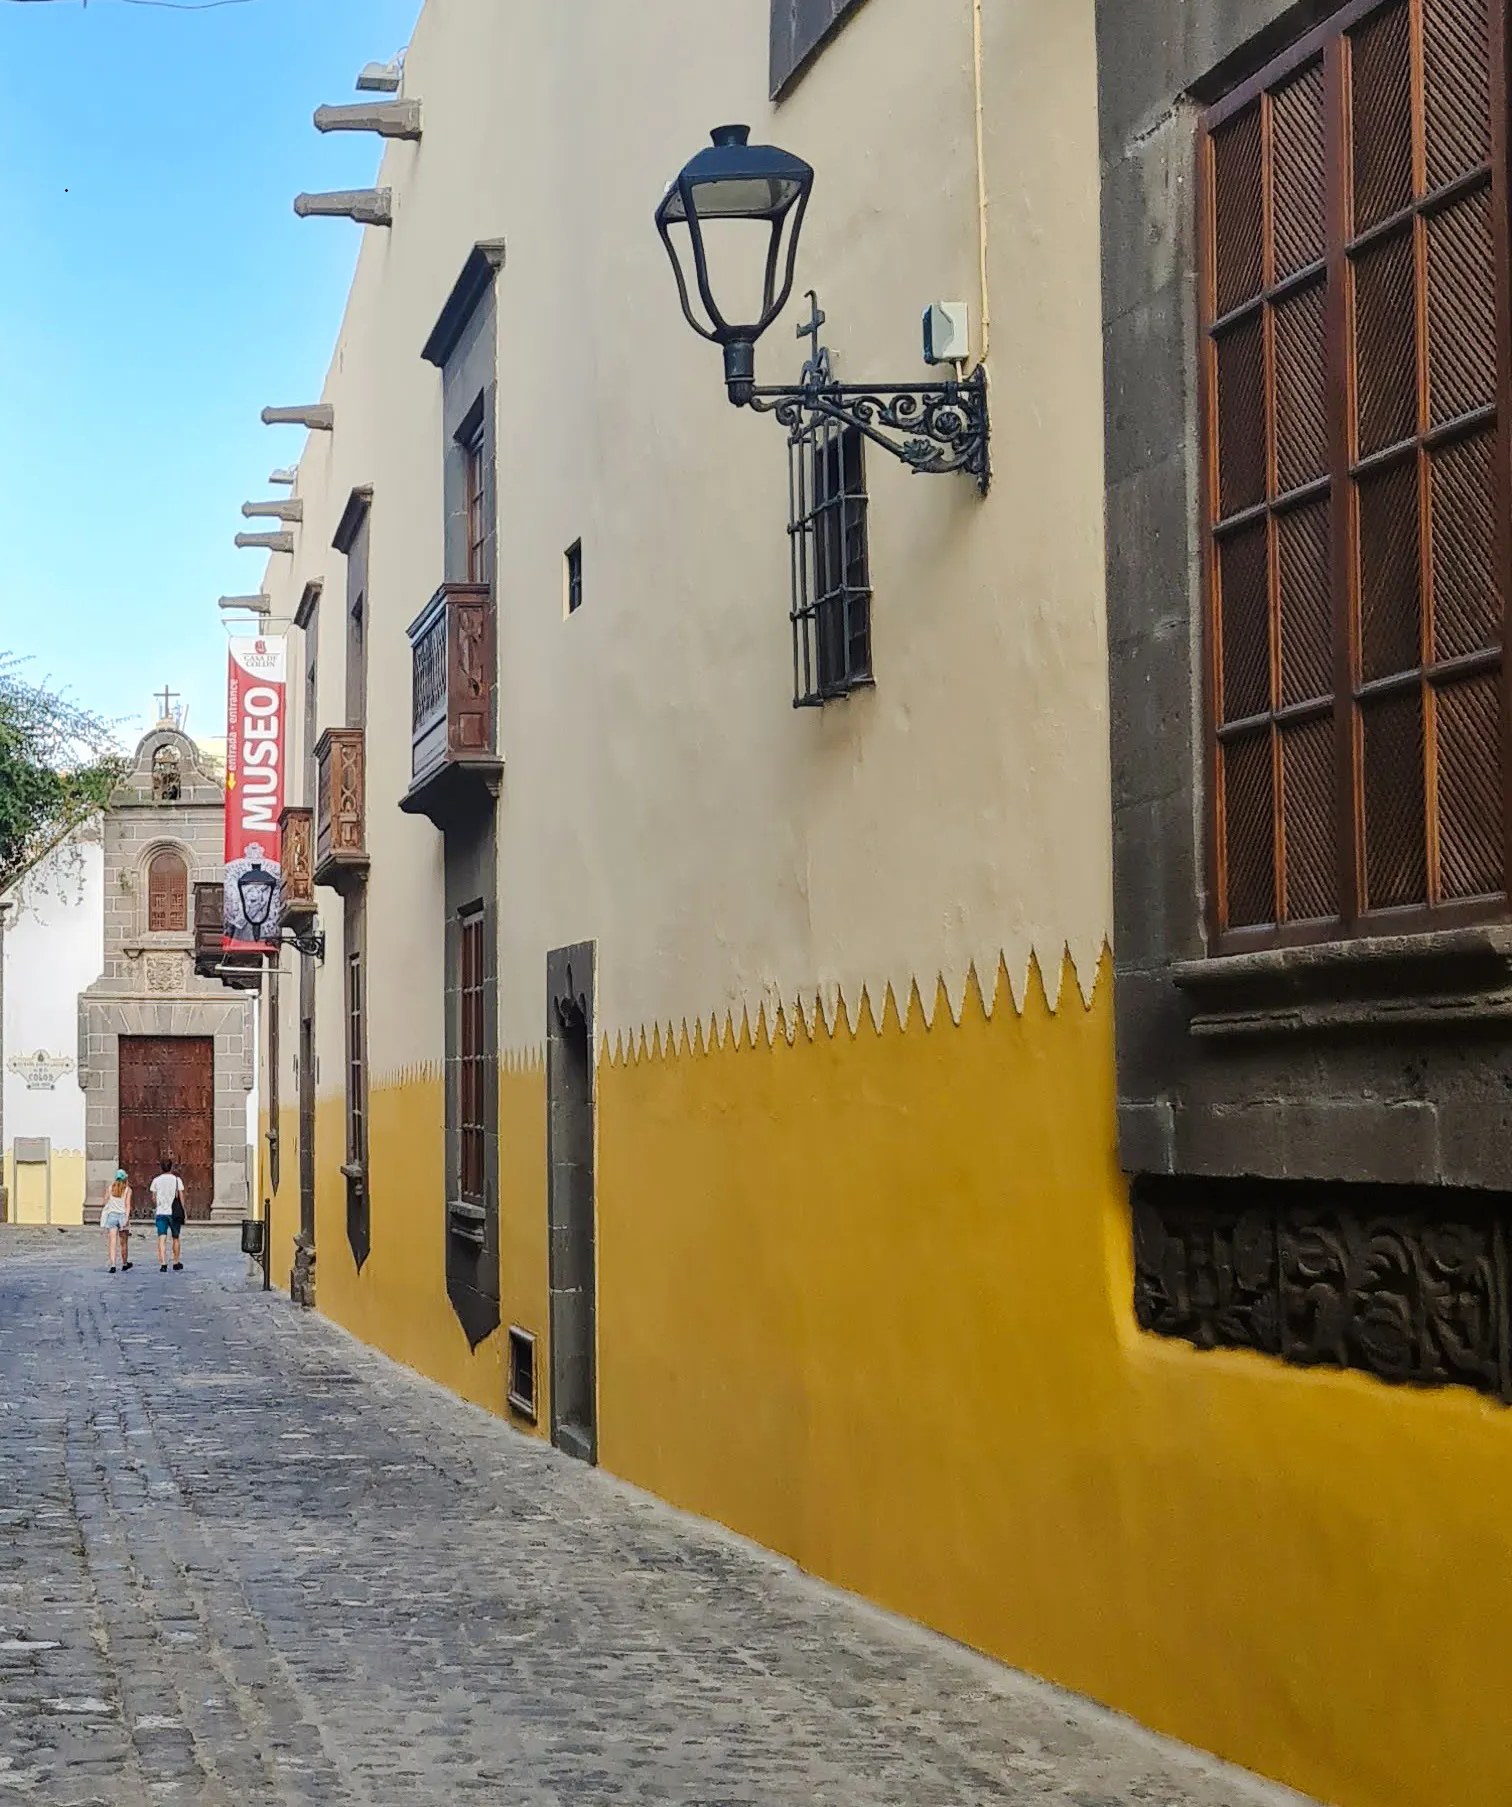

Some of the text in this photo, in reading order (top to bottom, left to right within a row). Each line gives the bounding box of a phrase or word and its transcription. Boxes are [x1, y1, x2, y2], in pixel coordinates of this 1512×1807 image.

[229, 679, 238, 724] entrance
[228, 731, 237, 771] entrada
[242, 686, 279, 832] MUSEO
